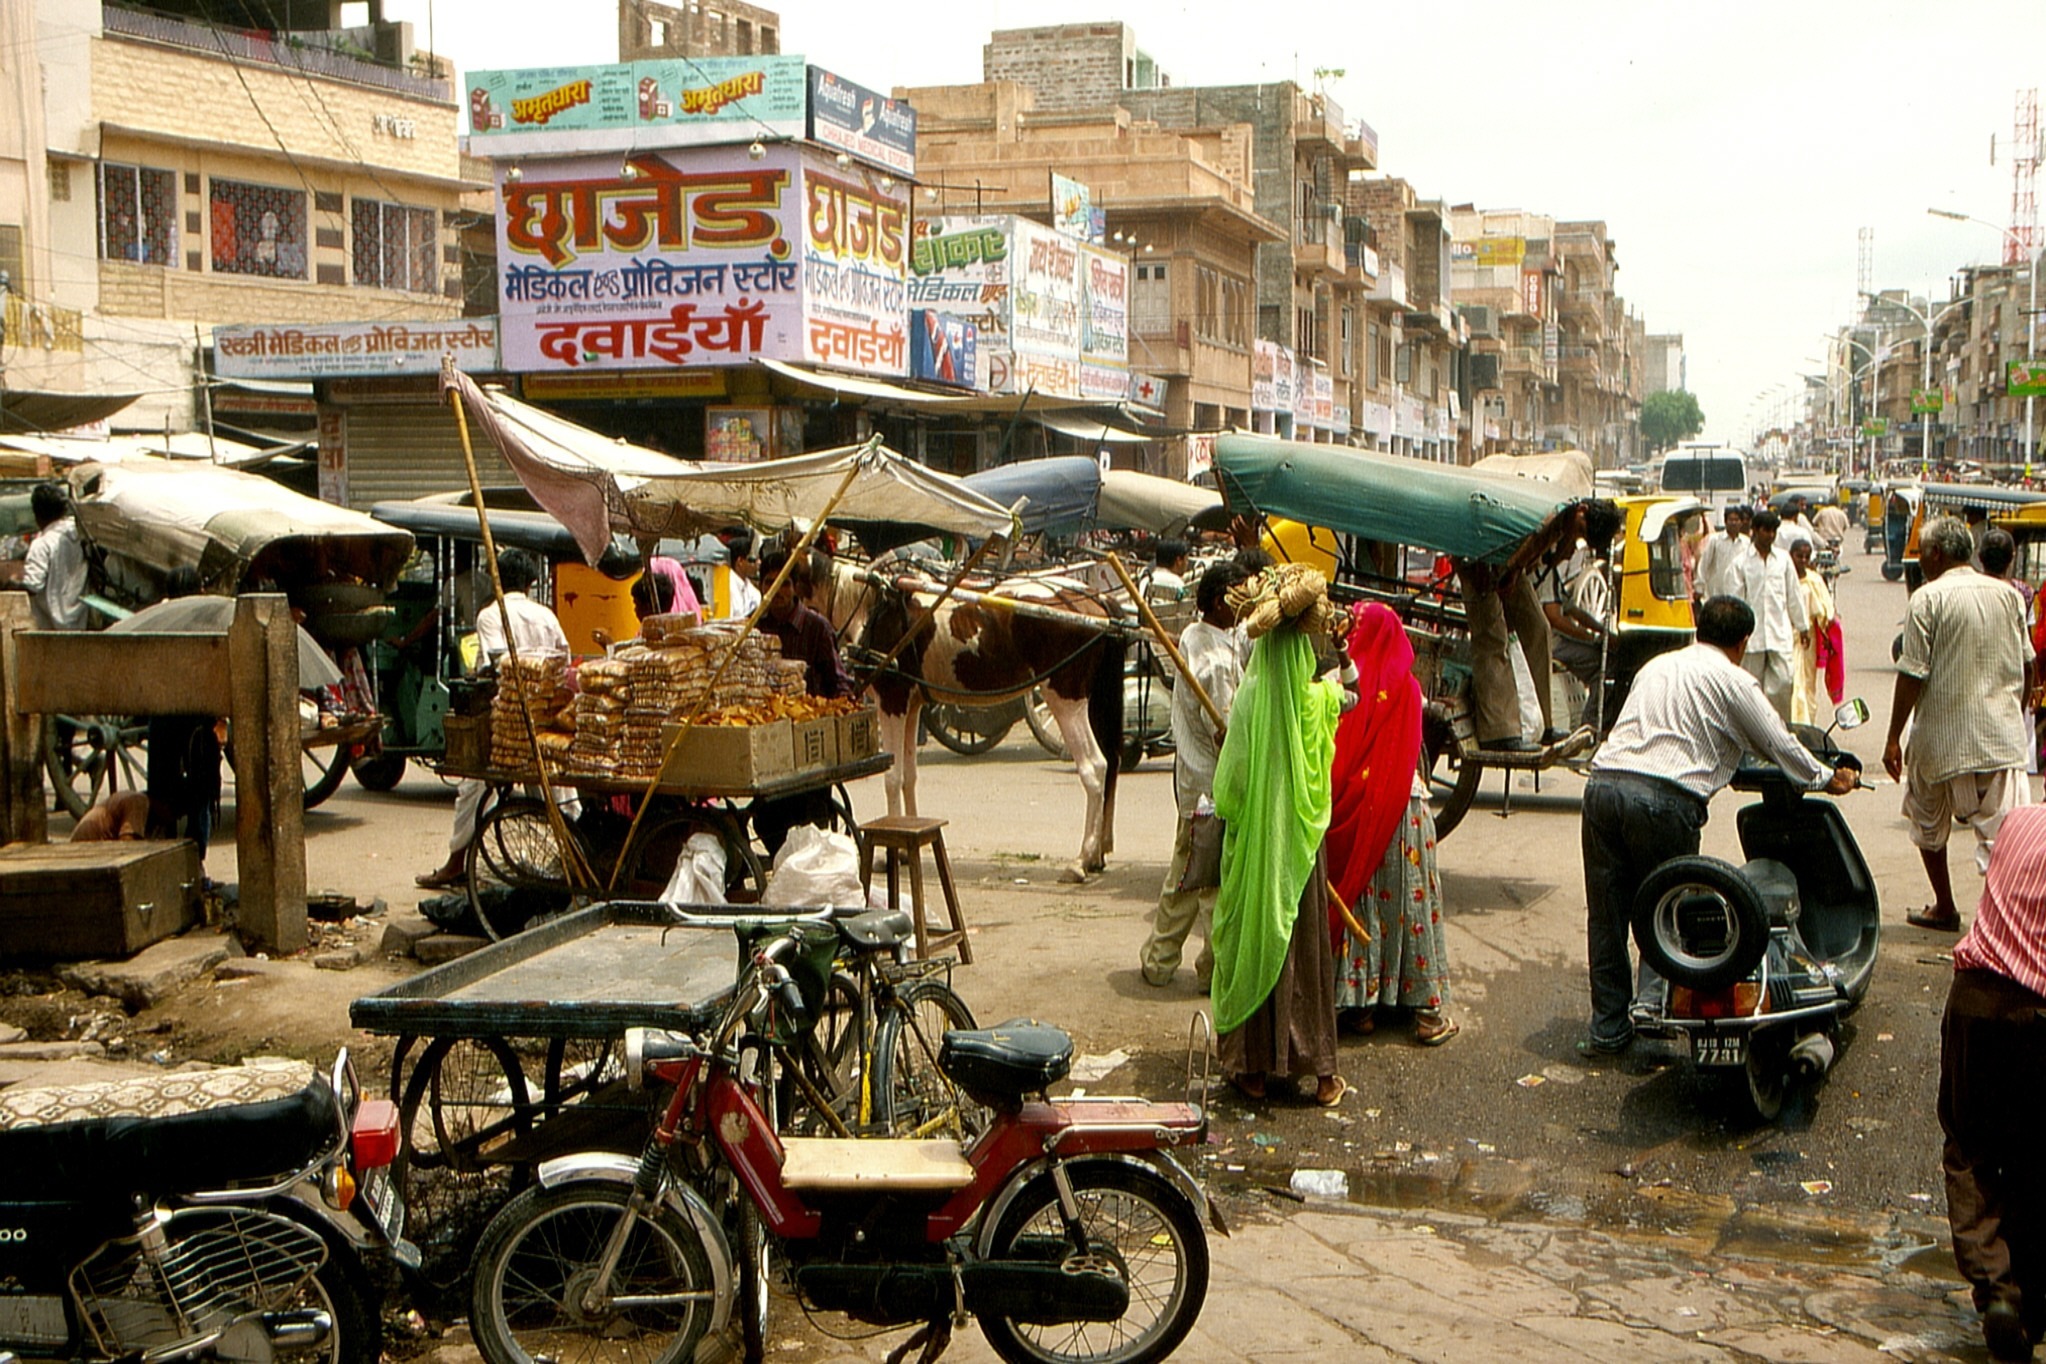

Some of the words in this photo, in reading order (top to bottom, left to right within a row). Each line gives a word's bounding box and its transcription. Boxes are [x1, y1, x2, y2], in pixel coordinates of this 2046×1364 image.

[511, 78, 594, 124] अमृतधारा
[680, 71, 766, 123] अमृतधारा
[505, 262, 593, 300] मेडिकल
[620, 258, 728, 299] प्रोविजन
[732, 254, 797, 293] स्टोर
[907, 276, 981, 301] मेडिकल
[268, 329, 340, 355] मेडिकल
[364, 324, 443, 352] प्रोविजन
[444, 323, 494, 350] स्टोर
